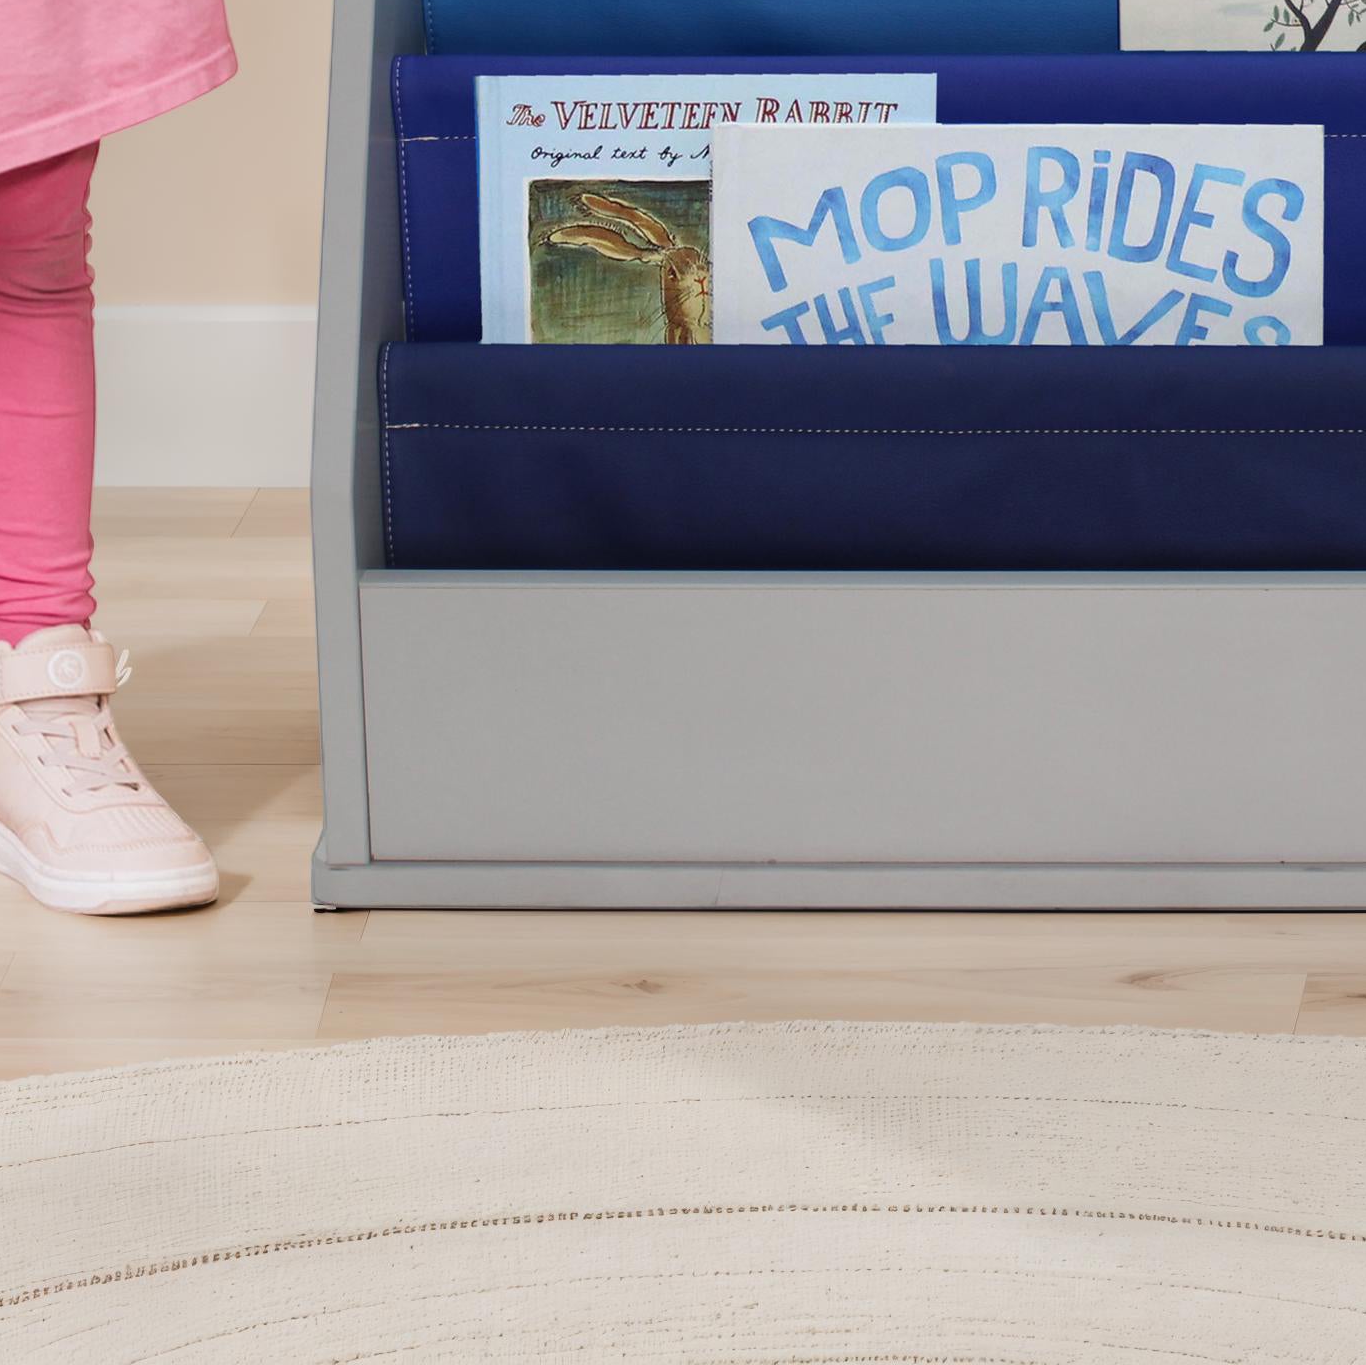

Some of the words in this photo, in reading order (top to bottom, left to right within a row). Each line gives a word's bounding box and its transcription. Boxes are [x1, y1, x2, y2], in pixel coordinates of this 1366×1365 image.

[506, 103, 546, 127] The
[531, 144, 603, 167] Original
[611, 146, 648, 160] text
[658, 145, 683, 167] by
[748, 150, 997, 292] MOP
